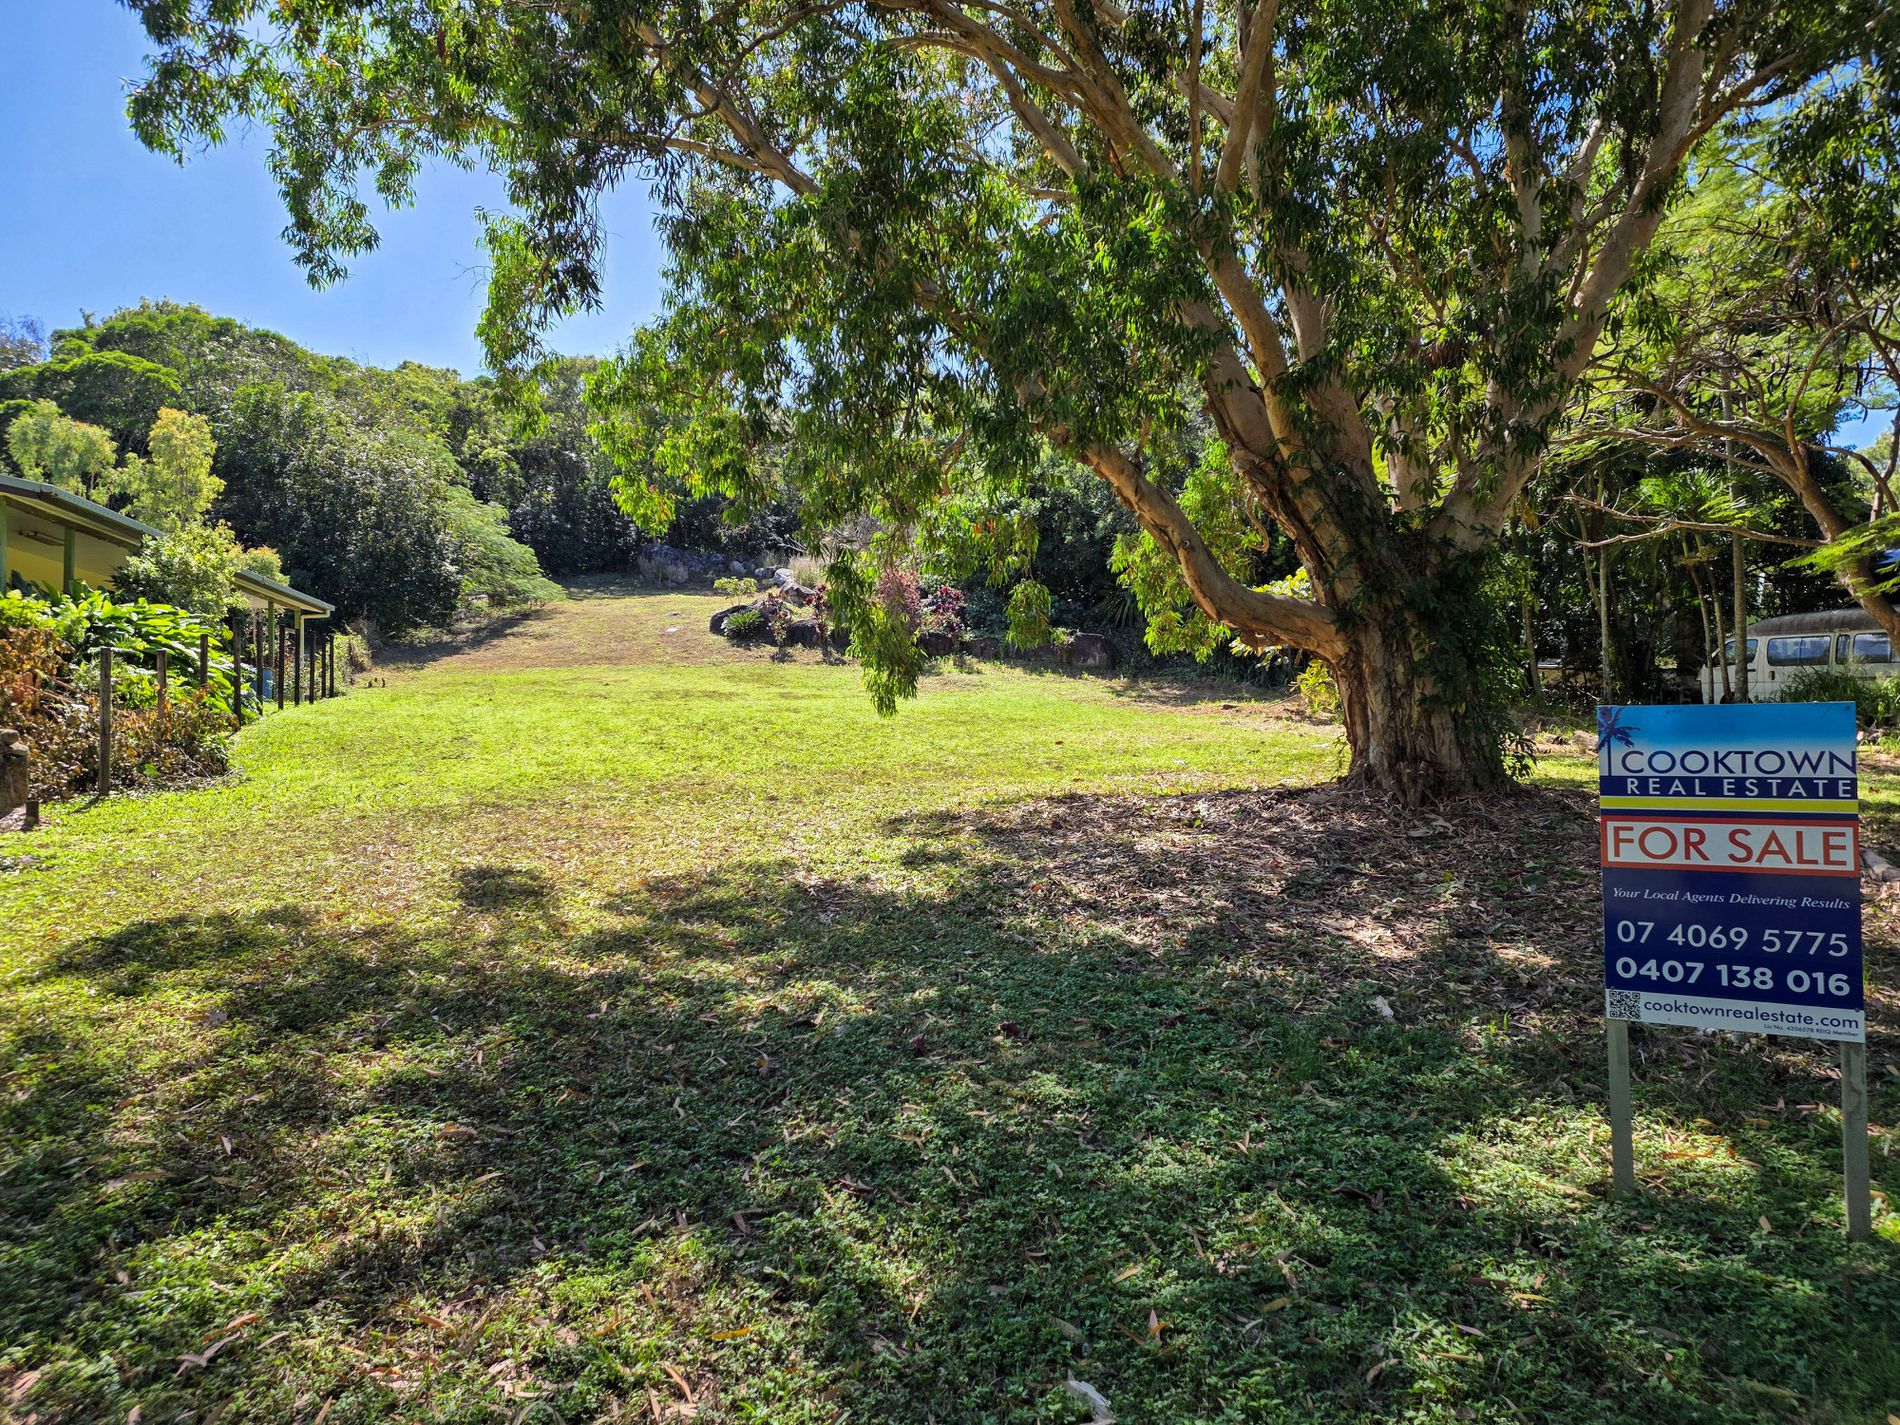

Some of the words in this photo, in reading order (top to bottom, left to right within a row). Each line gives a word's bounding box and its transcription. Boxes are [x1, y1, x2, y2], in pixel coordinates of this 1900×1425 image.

[1621, 749, 1857, 776] COOKTOWN
[1627, 778, 1706, 796] REAL
[1724, 779, 1851, 798] ESTATE
[1614, 826, 1709, 861] FOR
[1728, 828, 1846, 866] SALE
[1613, 887, 1640, 899] Your
[1643, 889, 1679, 900] Local
[1681, 891, 1725, 903] Agents
[1730, 893, 1797, 908] Delivering
[1801, 897, 1850, 909] Results
[1617, 920, 1655, 944] 07
[1667, 924, 1748, 950] 4069
[1762, 929, 1848, 957] 5775
[1616, 957, 1704, 983] 0407
[1716, 964, 1773, 990] 138
[1786, 970, 1851, 996] 016
[1644, 999, 1859, 1029] cooktownrealestate.com
